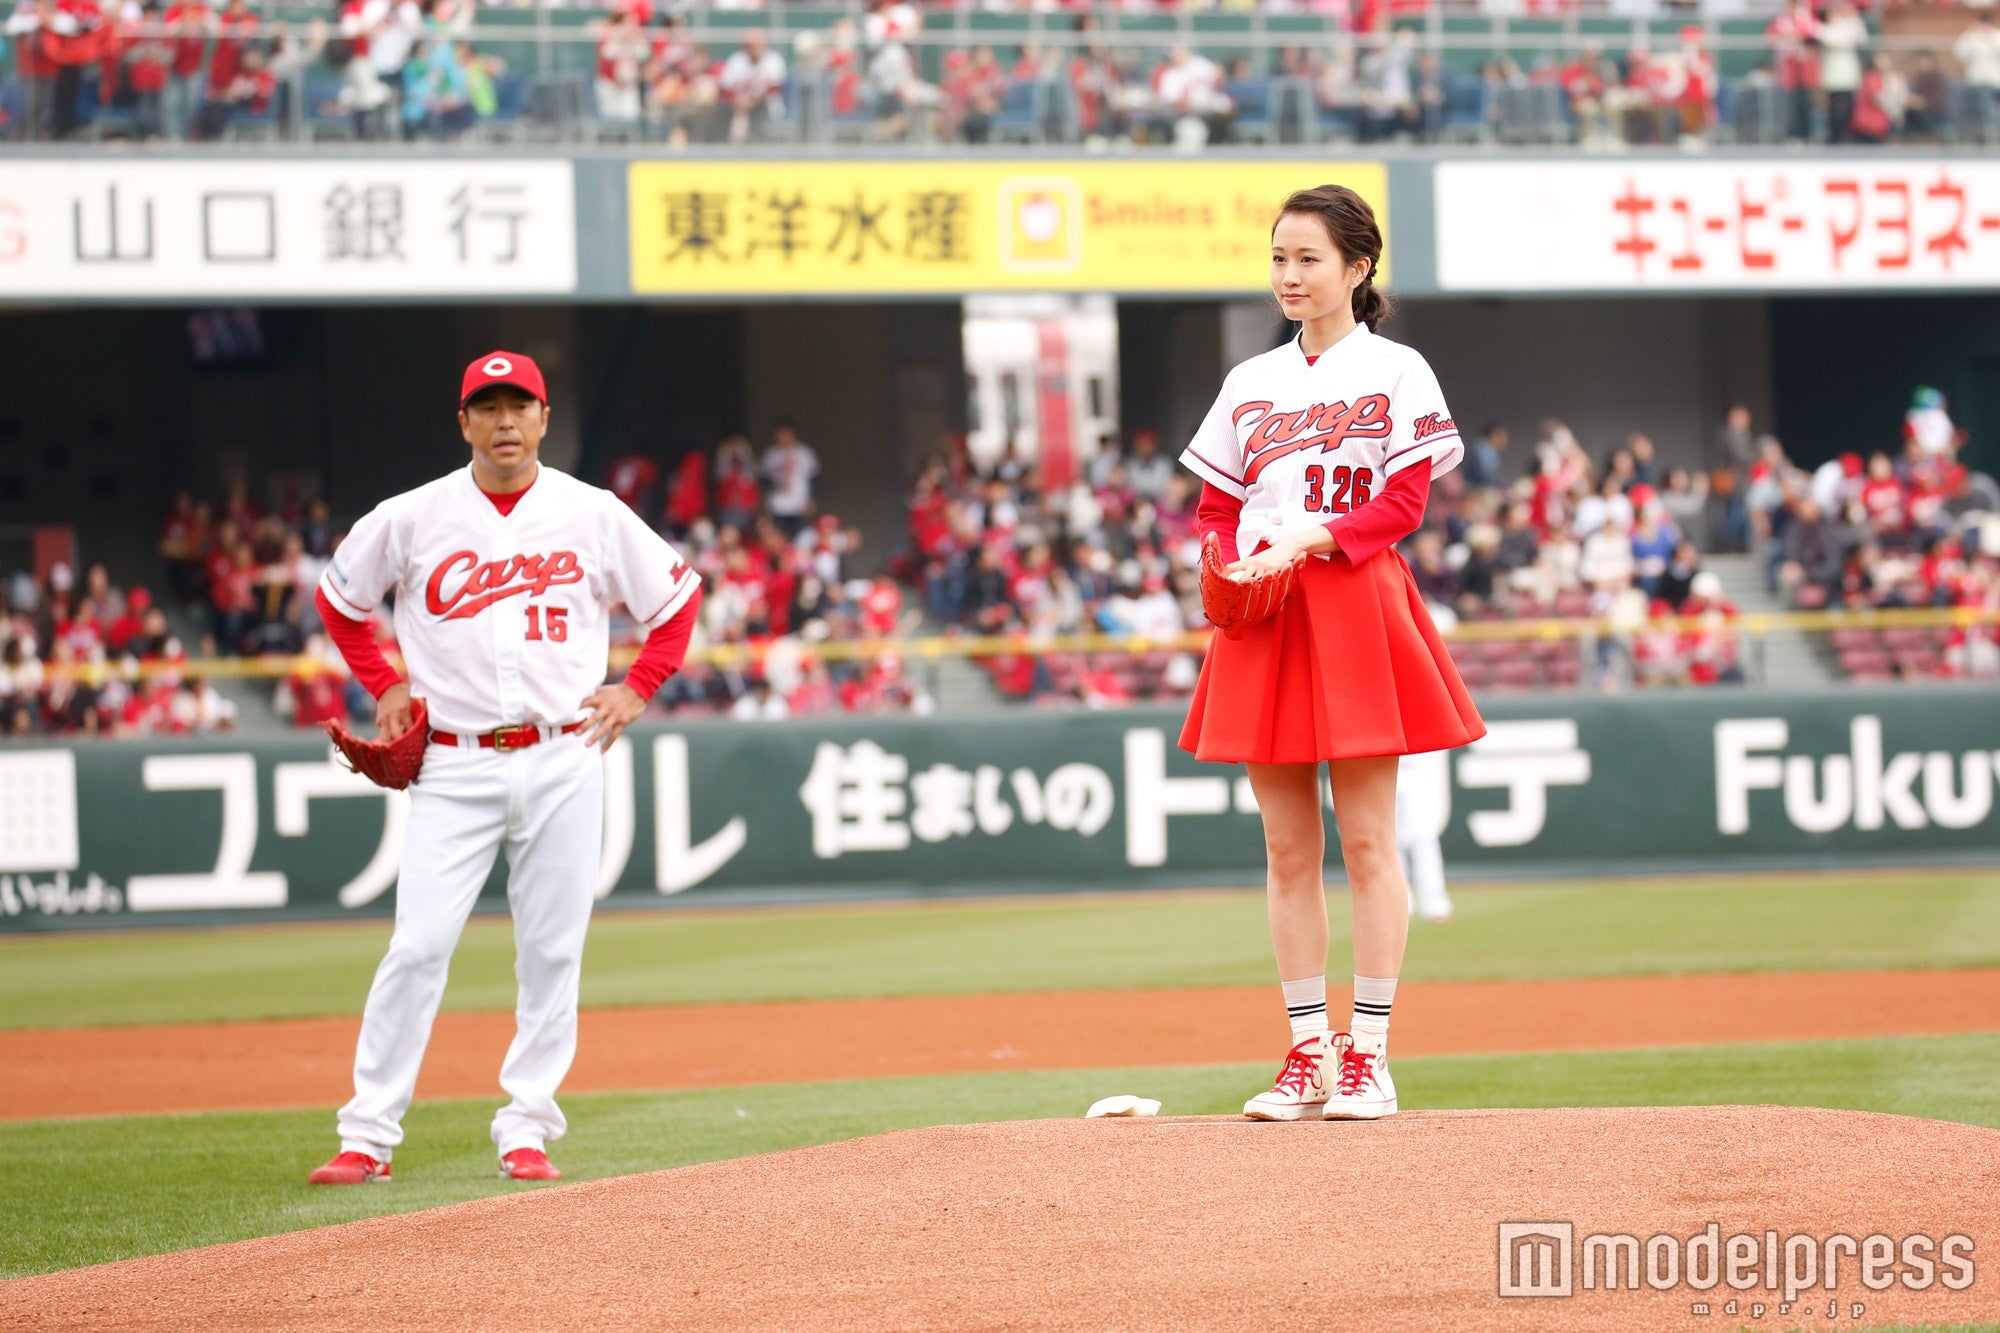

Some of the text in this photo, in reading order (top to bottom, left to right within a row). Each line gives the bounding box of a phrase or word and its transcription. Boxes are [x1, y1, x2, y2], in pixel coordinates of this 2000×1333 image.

[73, 182, 529, 263] 山口銀行
[661, 189, 972, 265] 東洋水産
[1086, 193, 1214, 227] Smiles
[1232, 393, 1393, 487] Carp
[1305, 465, 1373, 513] 3.26
[426, 550, 584, 622] Carp
[524, 605, 568, 642] 15
[1714, 714, 2000, 836] Fuku
